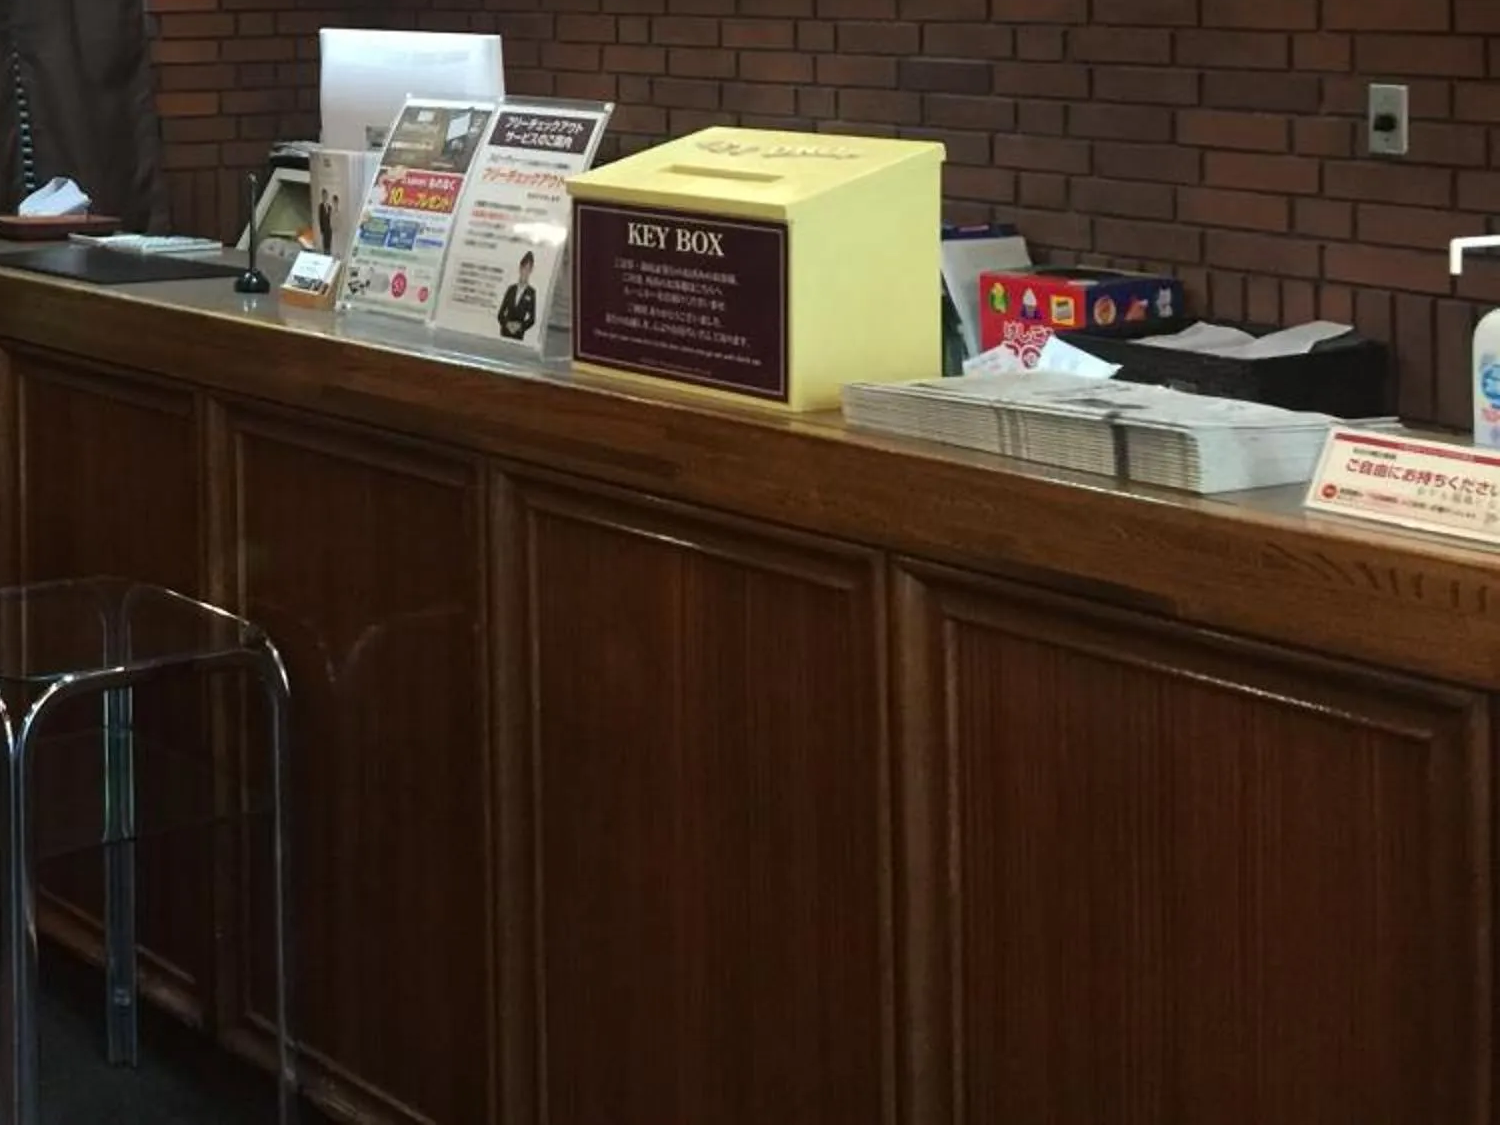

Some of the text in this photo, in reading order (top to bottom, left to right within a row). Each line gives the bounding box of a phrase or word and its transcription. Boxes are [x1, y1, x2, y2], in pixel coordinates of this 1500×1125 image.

[504, 115, 585, 134] フリーチェックアウト
[503, 131, 573, 150] サービスのご案内
[627, 221, 725, 257] KEY BOX
